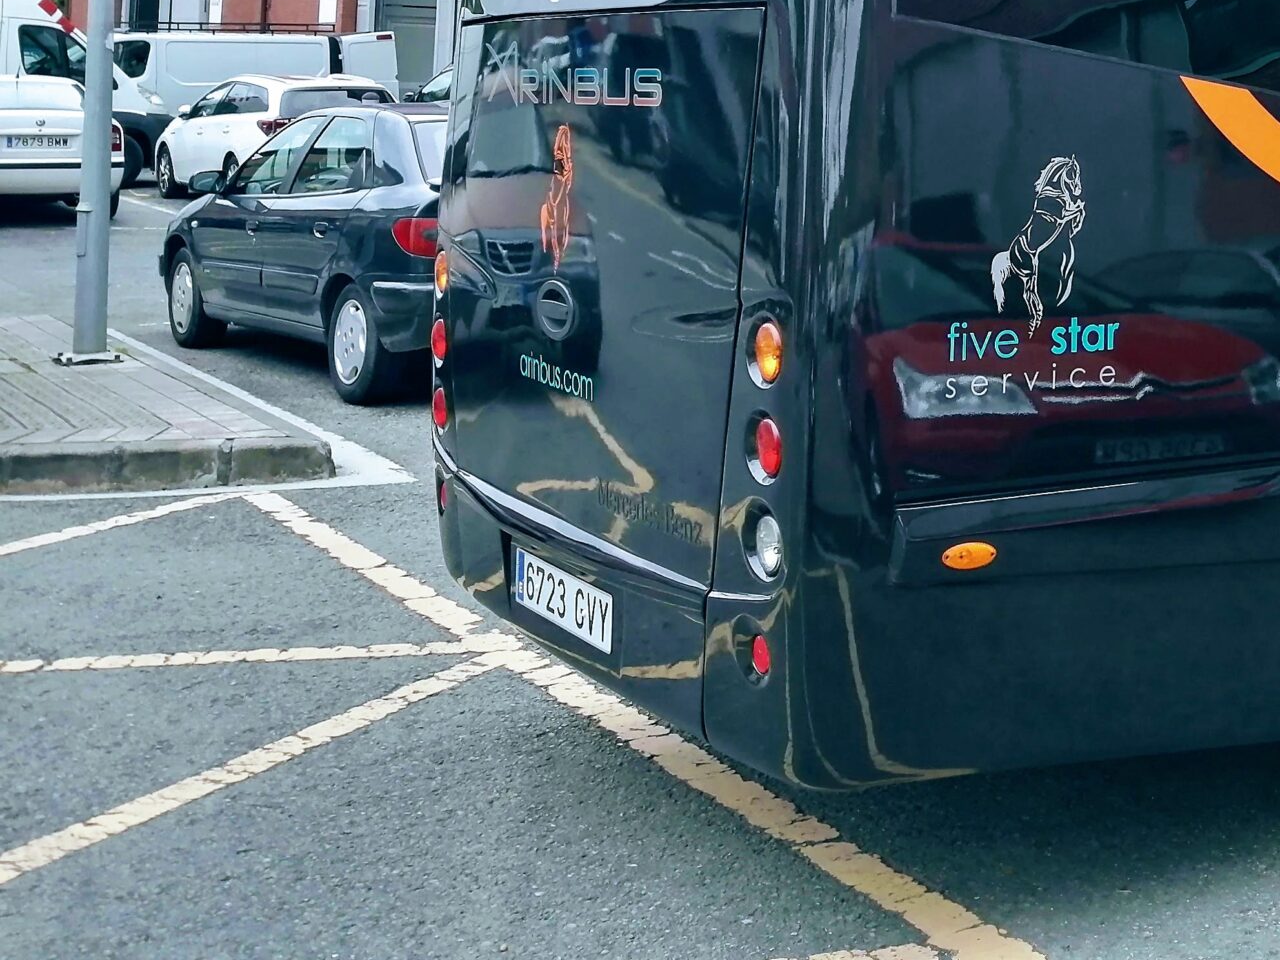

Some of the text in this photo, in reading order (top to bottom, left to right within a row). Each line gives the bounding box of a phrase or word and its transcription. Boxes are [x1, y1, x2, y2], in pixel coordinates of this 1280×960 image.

[14, 137, 68, 147] 7879 BMW
[947, 316, 1120, 362] five star
[519, 350, 594, 402] arinbus.com
[945, 363, 1116, 399] service
[526, 561, 567, 619] 6723
[574, 587, 609, 643] GVY
